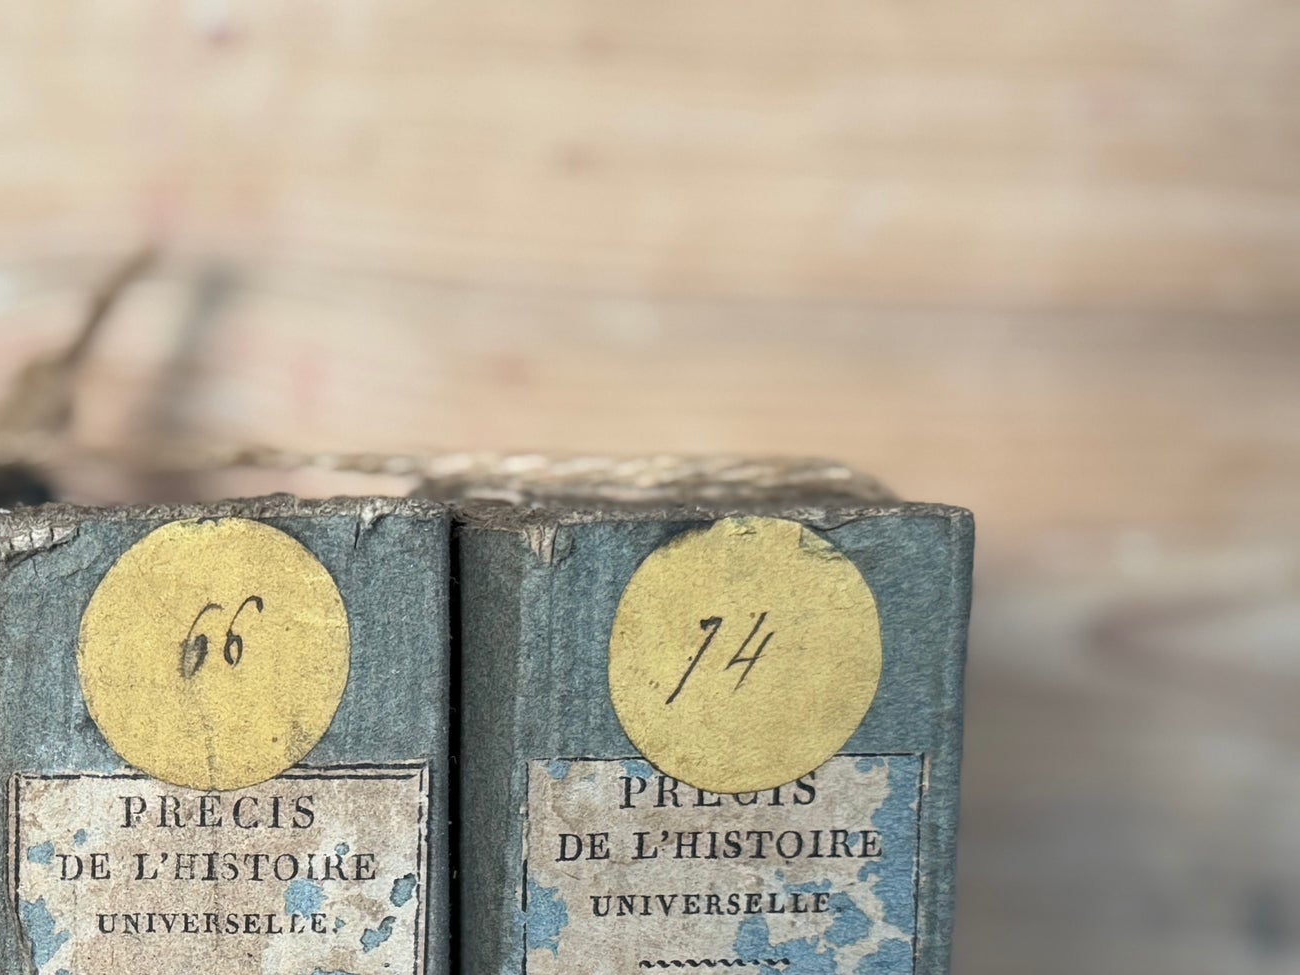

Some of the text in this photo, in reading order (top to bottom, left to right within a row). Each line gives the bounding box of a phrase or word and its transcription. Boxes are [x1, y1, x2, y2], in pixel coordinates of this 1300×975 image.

[176, 594, 264, 680] 66
[664, 611, 776, 705] 74
[56, 851, 377, 882] DE L'HISTOIRE
[555, 829, 883, 862] DE L'HISTOIRE
